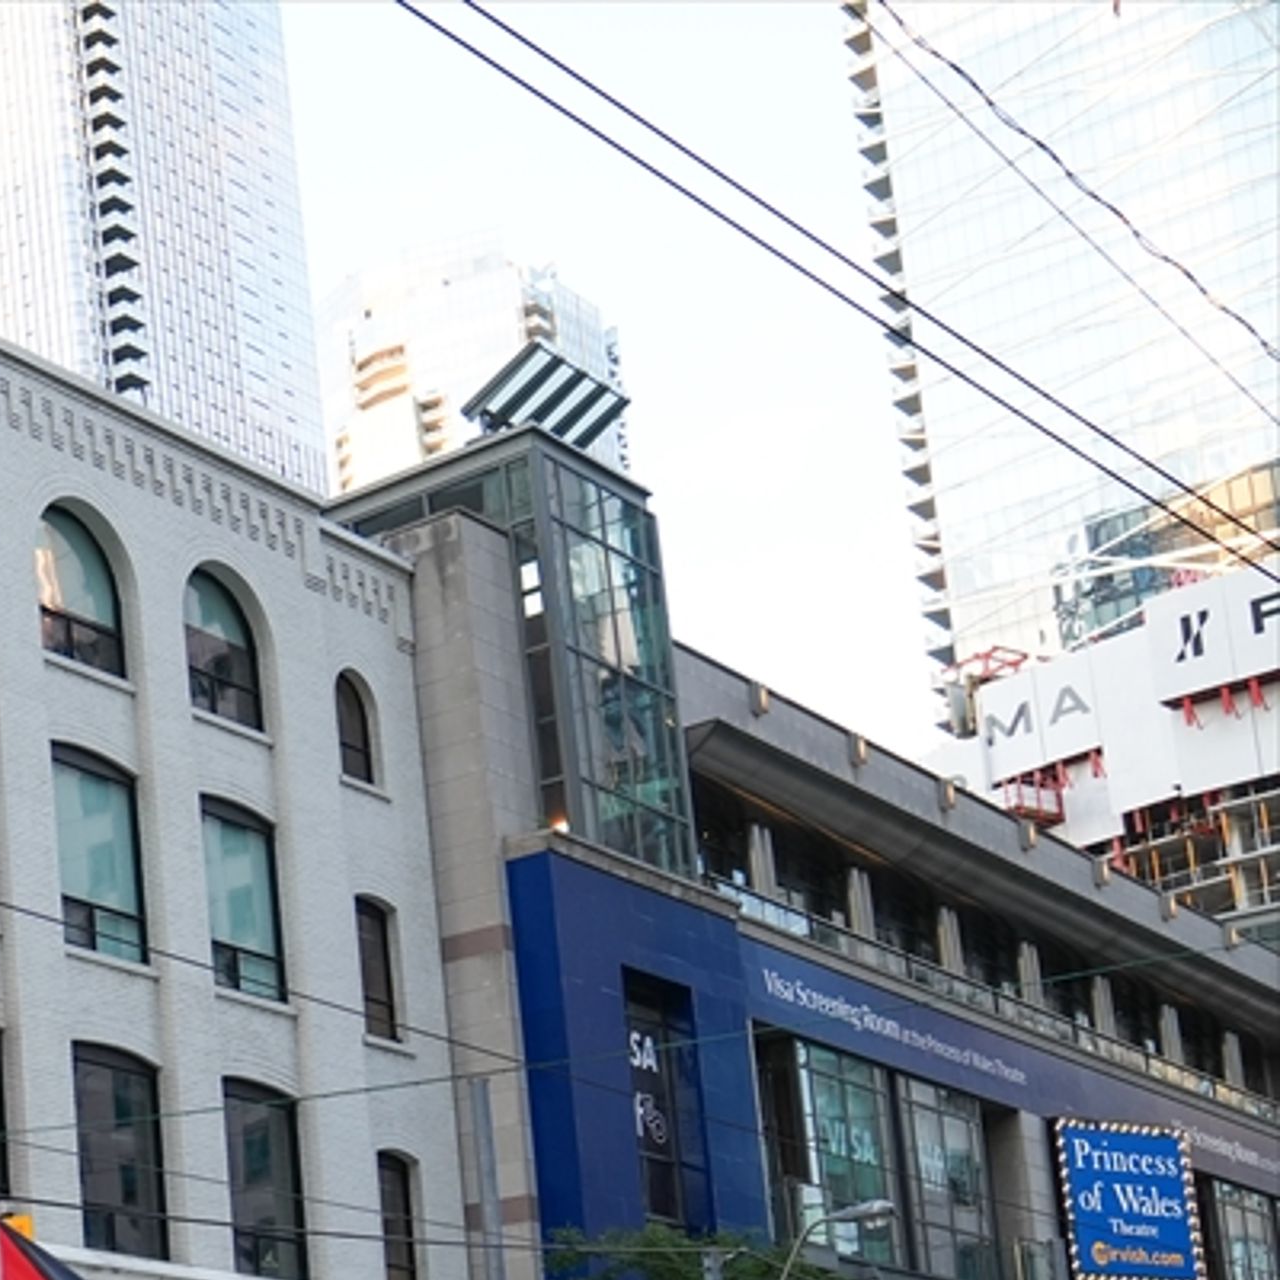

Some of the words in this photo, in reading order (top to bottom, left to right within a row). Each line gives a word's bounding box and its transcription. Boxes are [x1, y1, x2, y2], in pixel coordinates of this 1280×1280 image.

[763, 969, 794, 1003] Visa
[794, 981, 862, 1031] Screening
[860, 1006, 900, 1041] Room
[1072, 1138, 1179, 1177] Princess
[1077, 1180, 1104, 1213] of
[1112, 1183, 1184, 1219] Wales
[1109, 1218, 1159, 1238] Theatre
